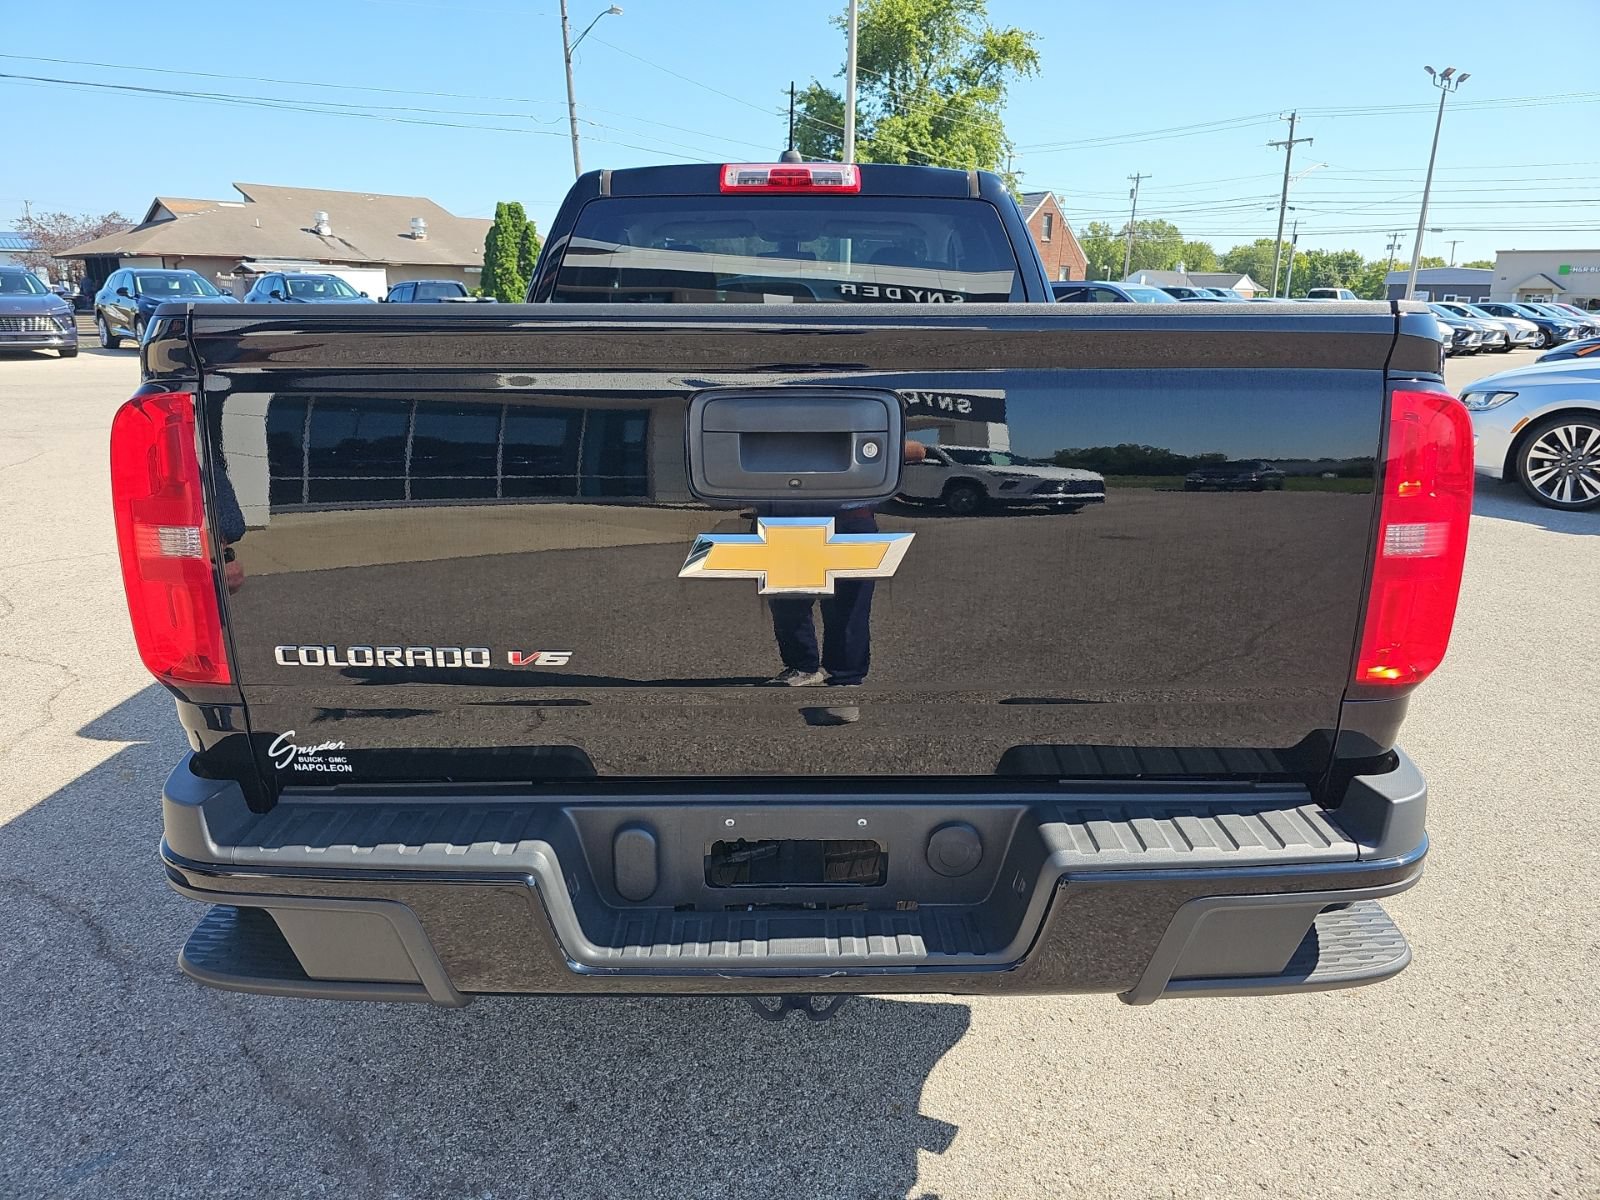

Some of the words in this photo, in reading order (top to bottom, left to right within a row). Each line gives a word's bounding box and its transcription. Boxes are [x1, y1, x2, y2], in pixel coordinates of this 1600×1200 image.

[274, 645, 491, 668] COLORADO
[507, 650, 573, 667] V6
[267, 729, 345, 769] Snyder
[294, 763, 353, 772] NAPOLEON
